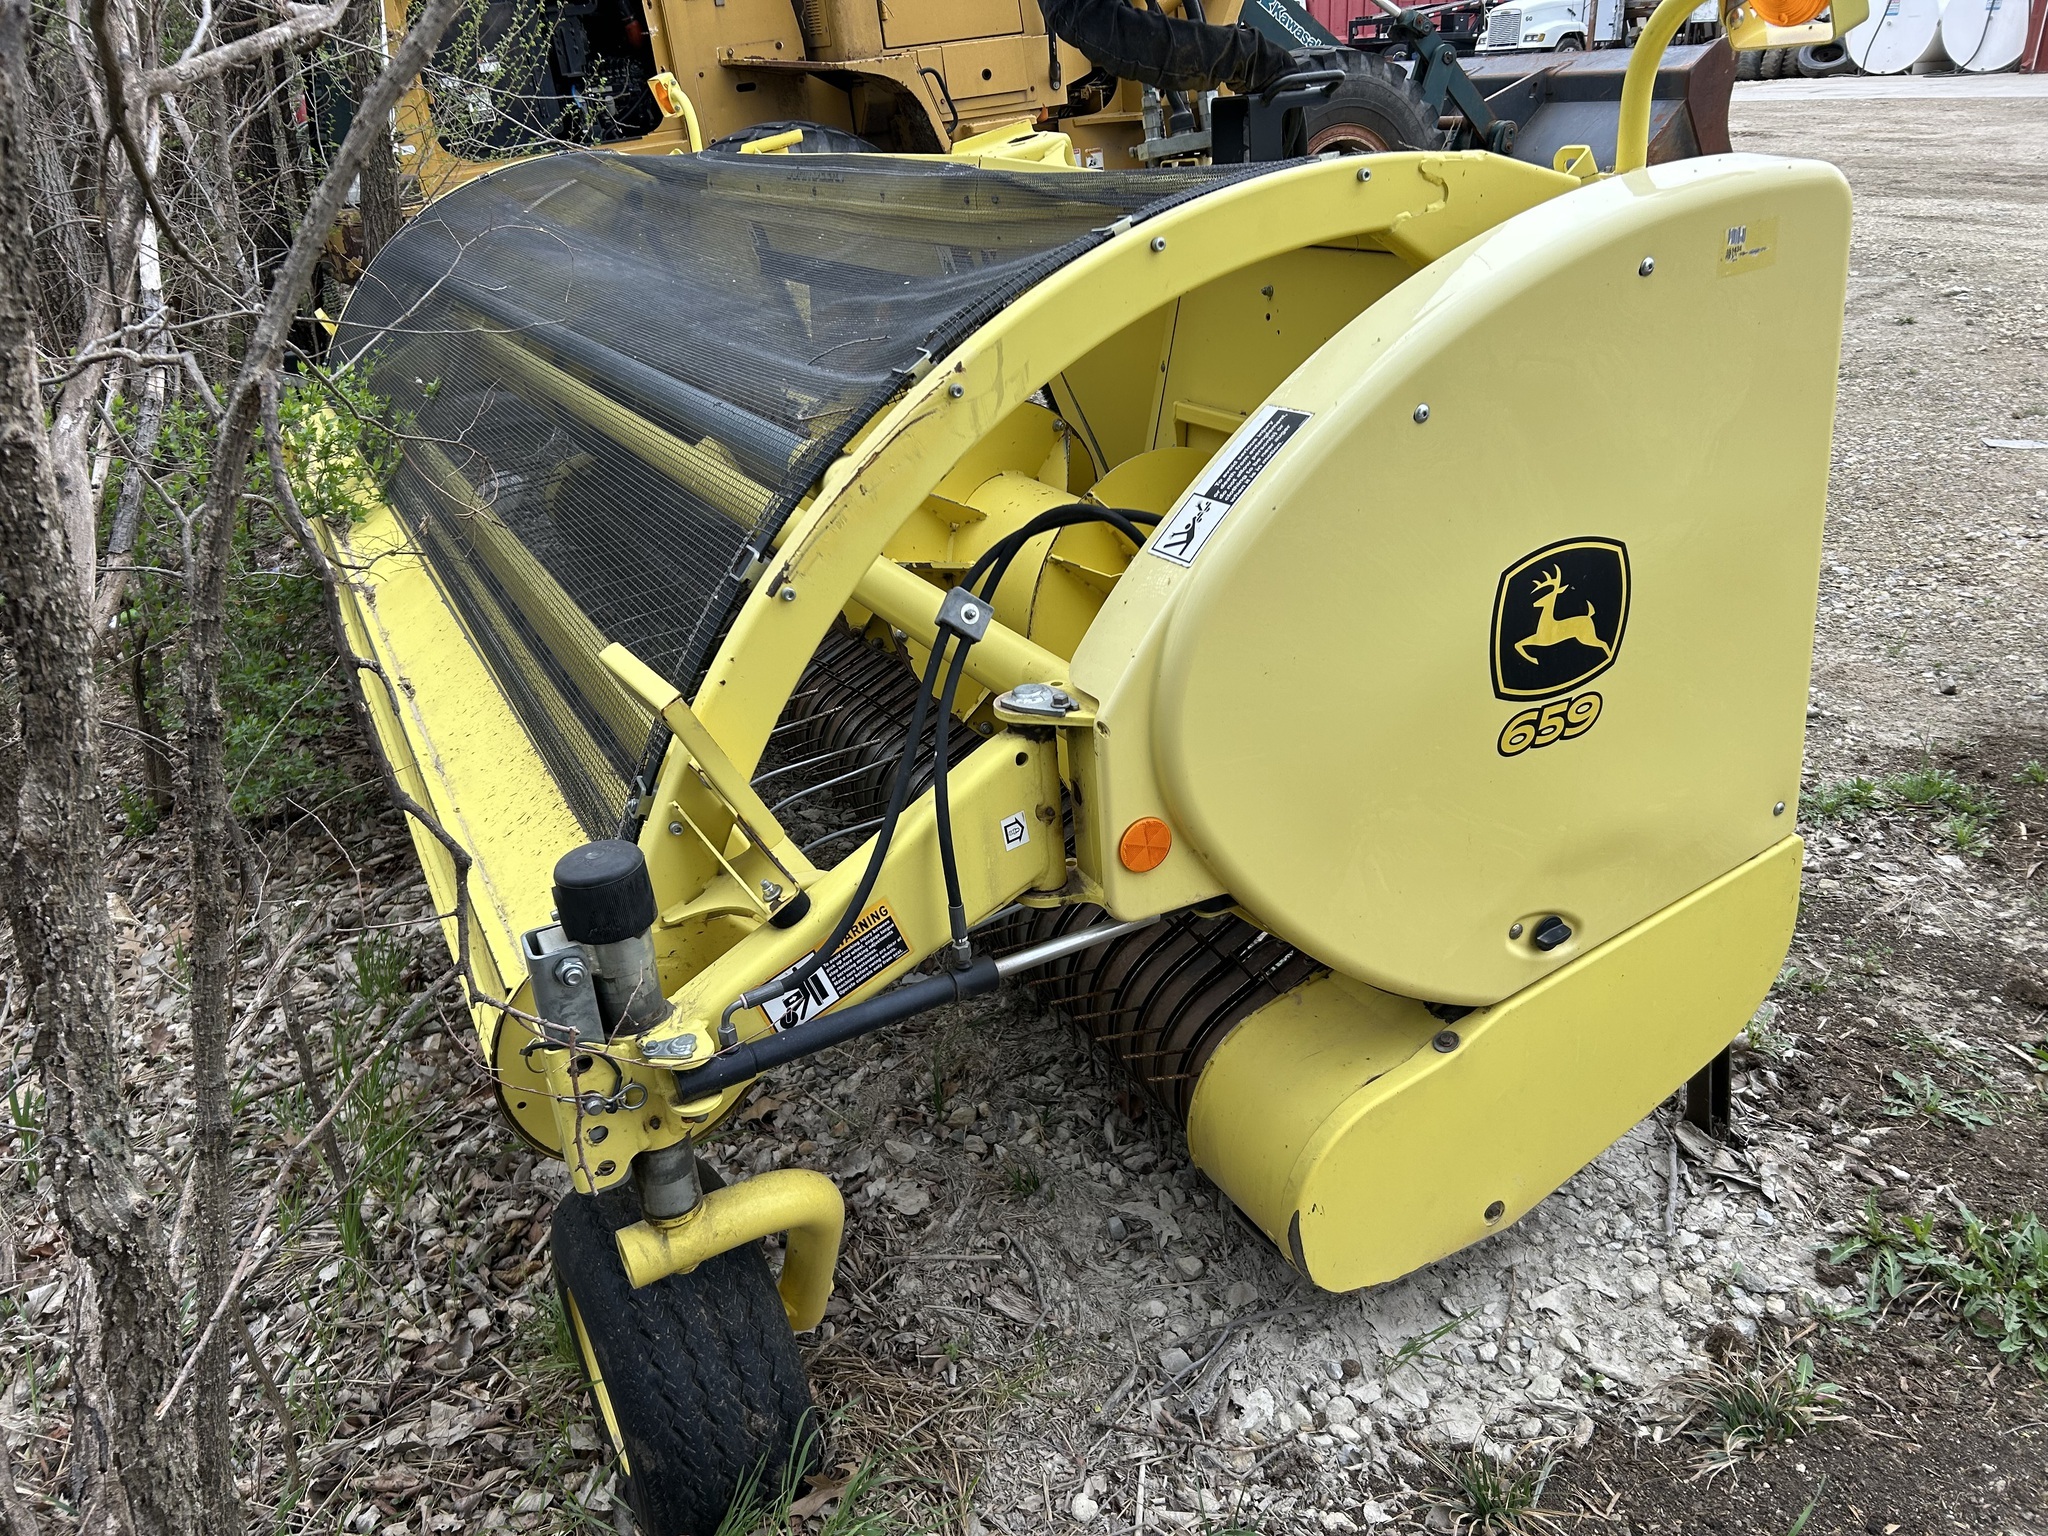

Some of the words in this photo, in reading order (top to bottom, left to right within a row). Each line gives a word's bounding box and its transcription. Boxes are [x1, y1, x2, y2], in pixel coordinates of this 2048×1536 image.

[1219, 490, 1227, 499] do
[1227, 478, 1237, 489] not
[1237, 461, 1251, 478] allow
[1251, 432, 1277, 460] person(s)
[1220, 471, 1236, 489] death
[1235, 455, 1249, 470] from
[1223, 461, 1238, 478] avoid
[1238, 438, 1258, 460] serious
[1257, 421, 1273, 437] injury
[1225, 475, 1247, 501] clothing
[1252, 458, 1261, 466] be
[1261, 443, 1273, 457] near
[1274, 425, 1290, 442] auger
[1230, 485, 1246, 502] when
[1262, 441, 1283, 464] motion.
[1497, 691, 1603, 757] 659
